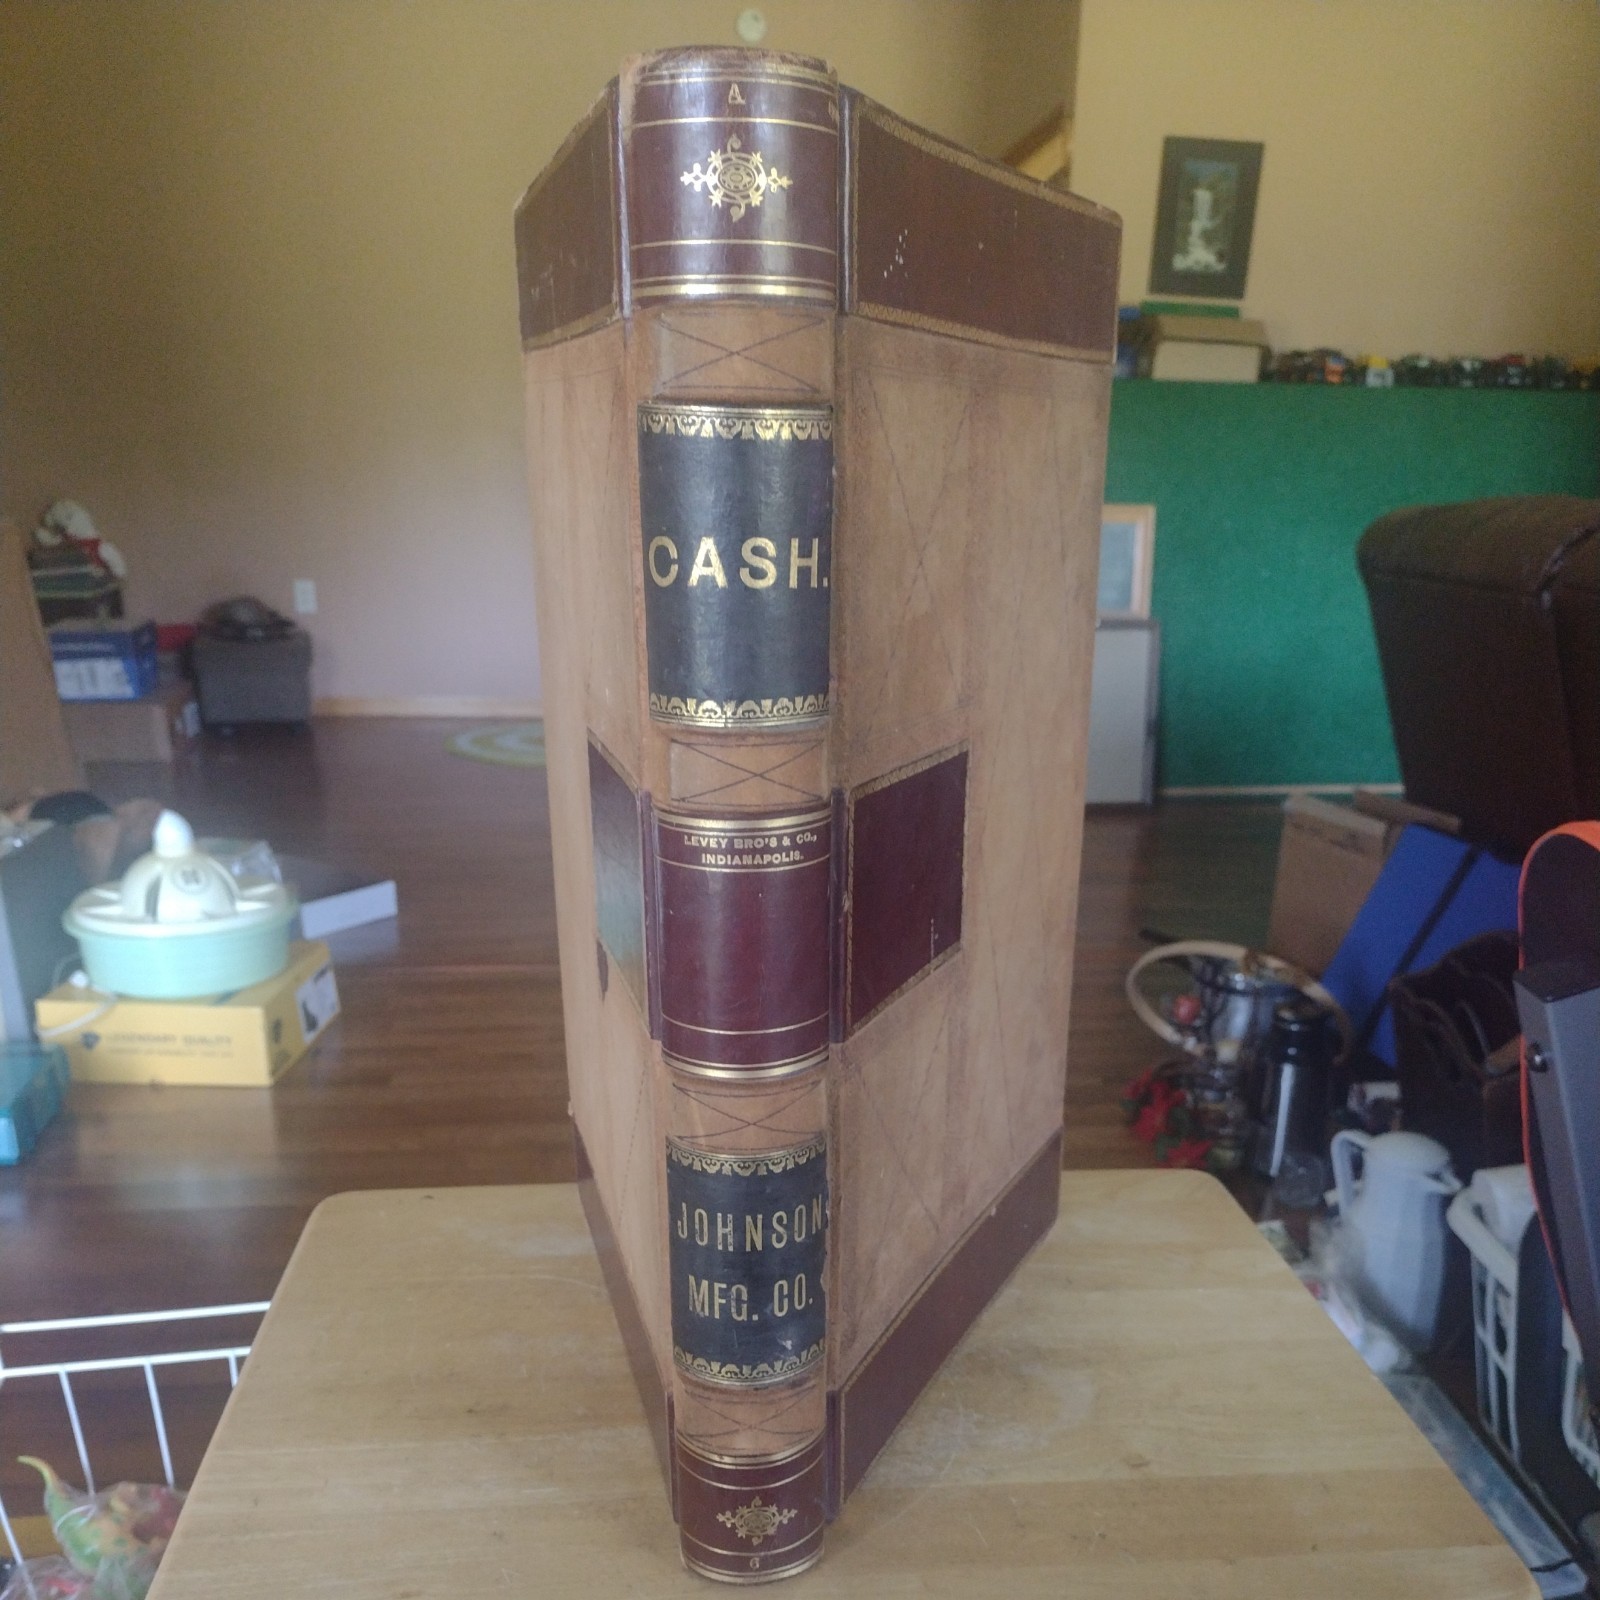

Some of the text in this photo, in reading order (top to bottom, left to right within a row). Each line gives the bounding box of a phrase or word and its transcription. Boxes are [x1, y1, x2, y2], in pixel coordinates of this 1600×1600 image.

[648, 535, 828, 589] CASH.
[684, 834, 728, 849] LEVEY
[734, 836, 777, 848] BRO'S
[782, 837, 791, 847] &
[677, 1193, 822, 1252] JOHNSON
[688, 1273, 813, 1321] MFG. CO.
